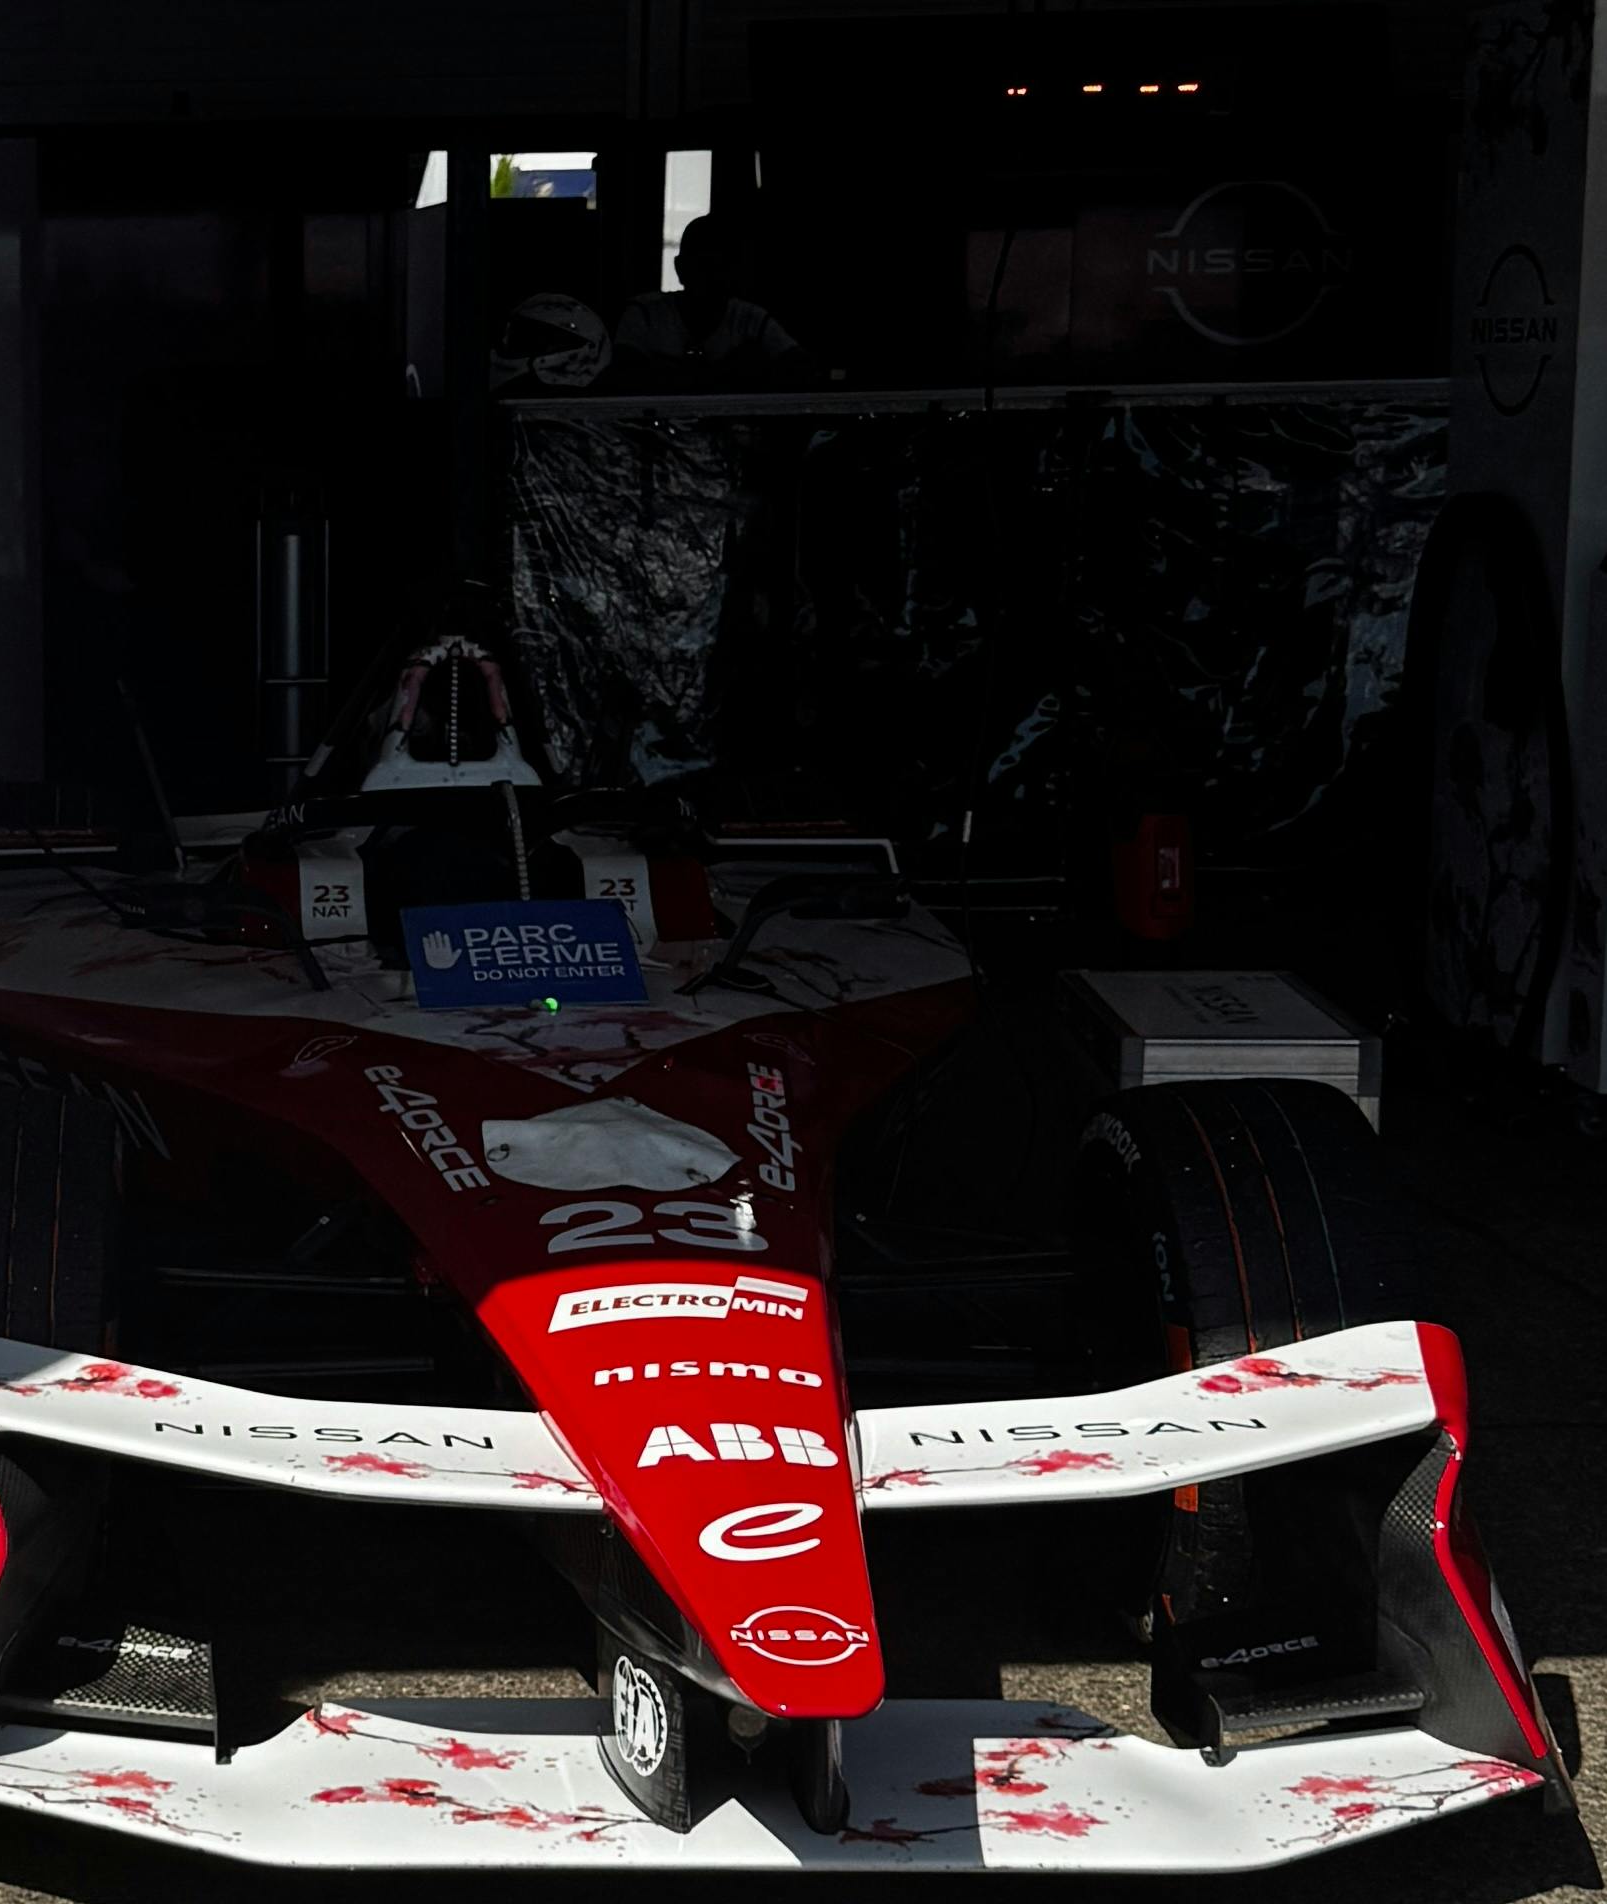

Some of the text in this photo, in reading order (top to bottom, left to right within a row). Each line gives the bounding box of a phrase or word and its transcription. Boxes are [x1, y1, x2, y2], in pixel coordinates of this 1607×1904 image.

[1146, 247, 1355, 274] NISSAN
[1471, 317, 1558, 344] NISSAN
[313, 885, 350, 903] 23
[599, 878, 636, 896] 23
[312, 905, 352, 919] NAT
[463, 924, 578, 946] PARC
[468, 943, 623, 967] FERME
[474, 965, 626, 981] DO NOT ENTER
[538, 1200, 770, 1254] 23
[569, 1293, 805, 1321] ELECTROMIN
[593, 1360, 823, 1388] nismo
[154, 1422, 495, 1450] NISSAN
[636, 1422, 840, 1469] ABB
[907, 1418, 1268, 1447] NISSAN
[730, 1629, 871, 1644] NISSAN
